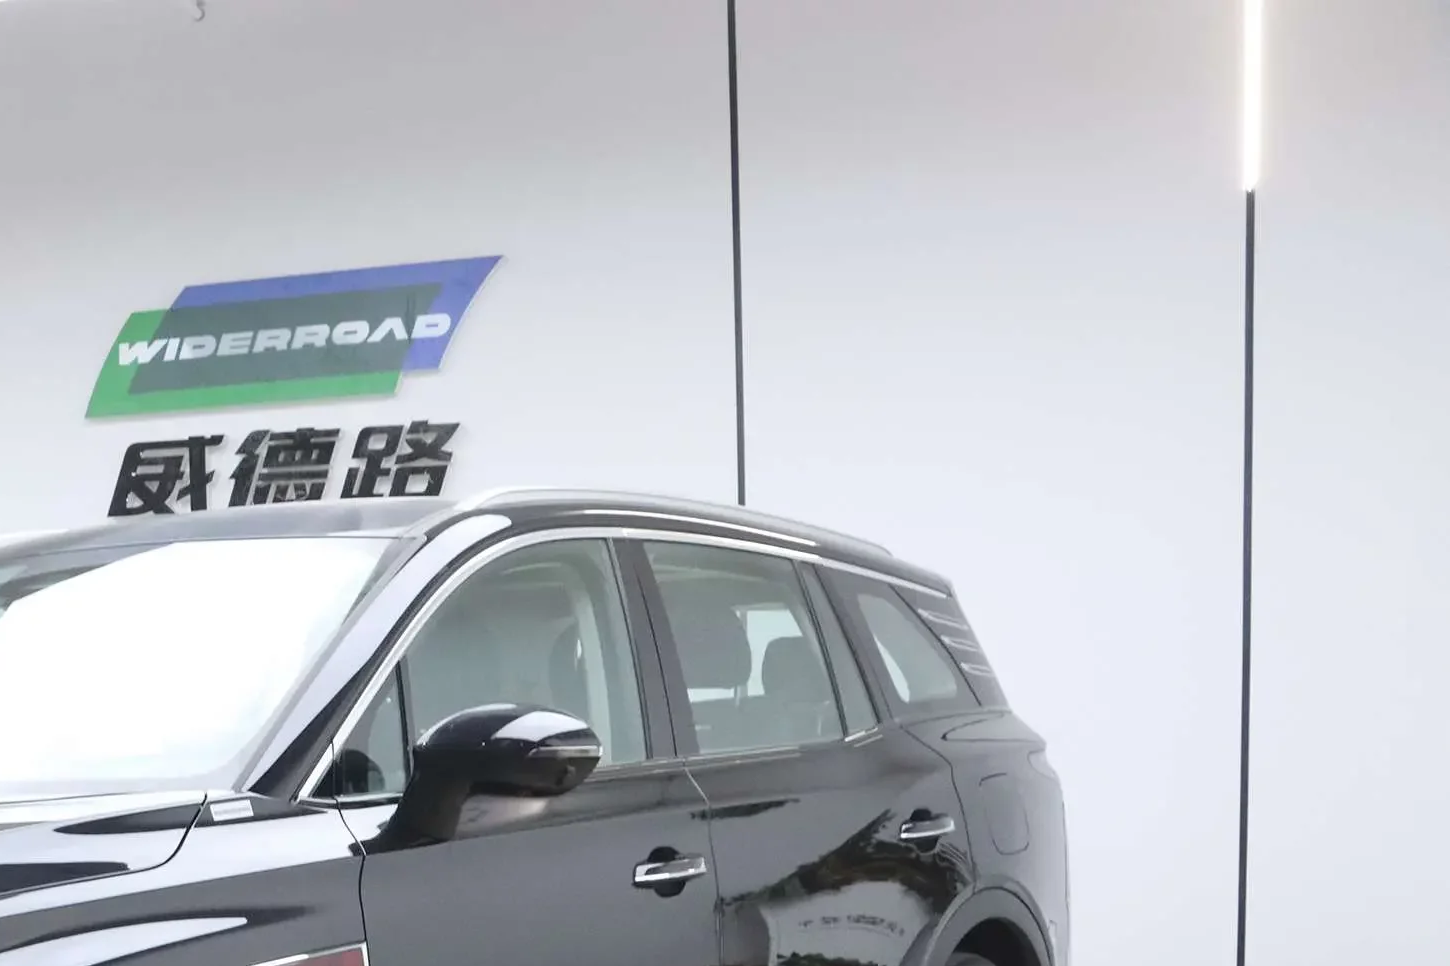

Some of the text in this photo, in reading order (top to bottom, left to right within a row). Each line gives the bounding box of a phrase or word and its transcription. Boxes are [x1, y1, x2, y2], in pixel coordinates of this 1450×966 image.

[118, 313, 451, 365] WIDERROAD
[108, 420, 461, 517] 威德路
